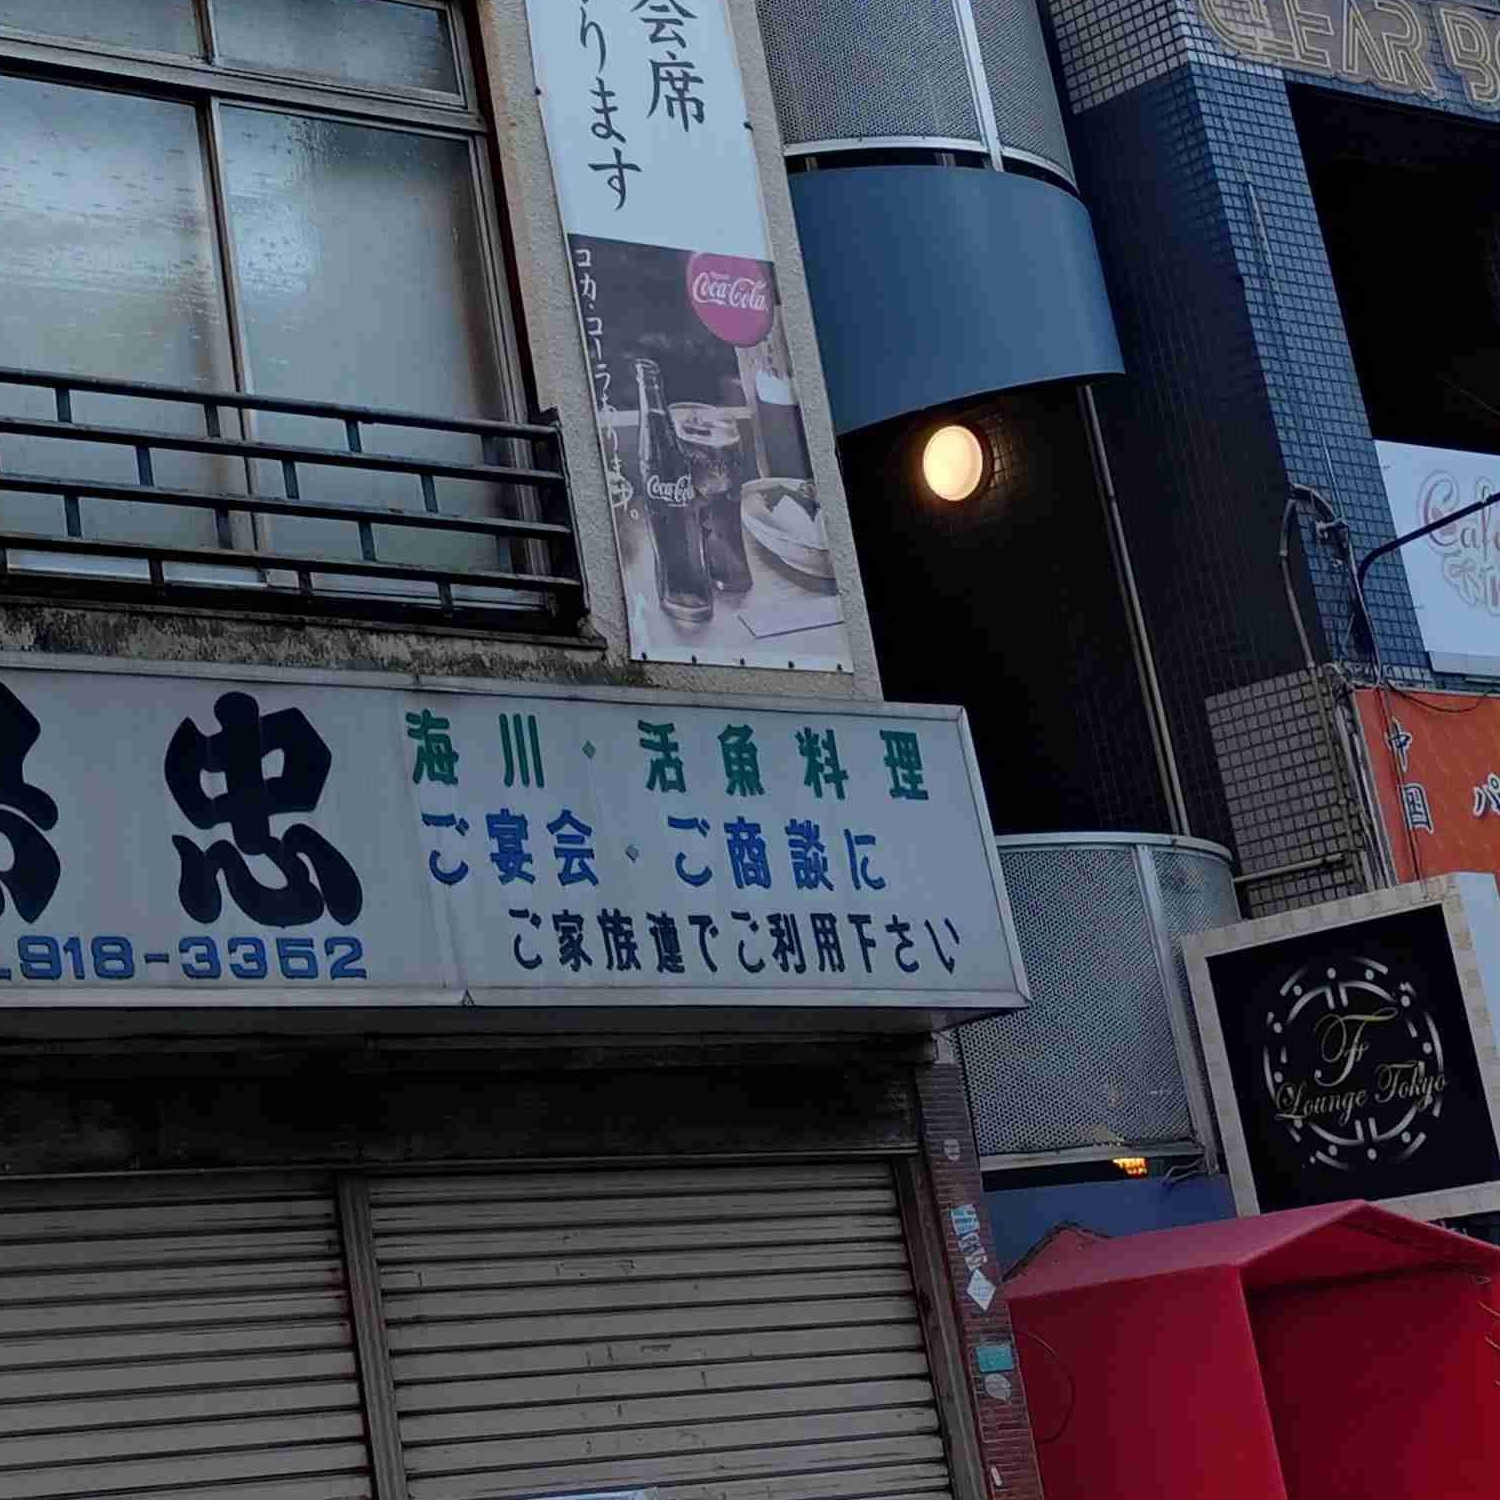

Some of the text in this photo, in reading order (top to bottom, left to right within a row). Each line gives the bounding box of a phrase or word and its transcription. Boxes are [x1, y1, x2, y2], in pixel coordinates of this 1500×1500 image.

[1441, 6, 1500, 102] B
[1275, 1059, 1447, 1127] Lounge Tokyo
